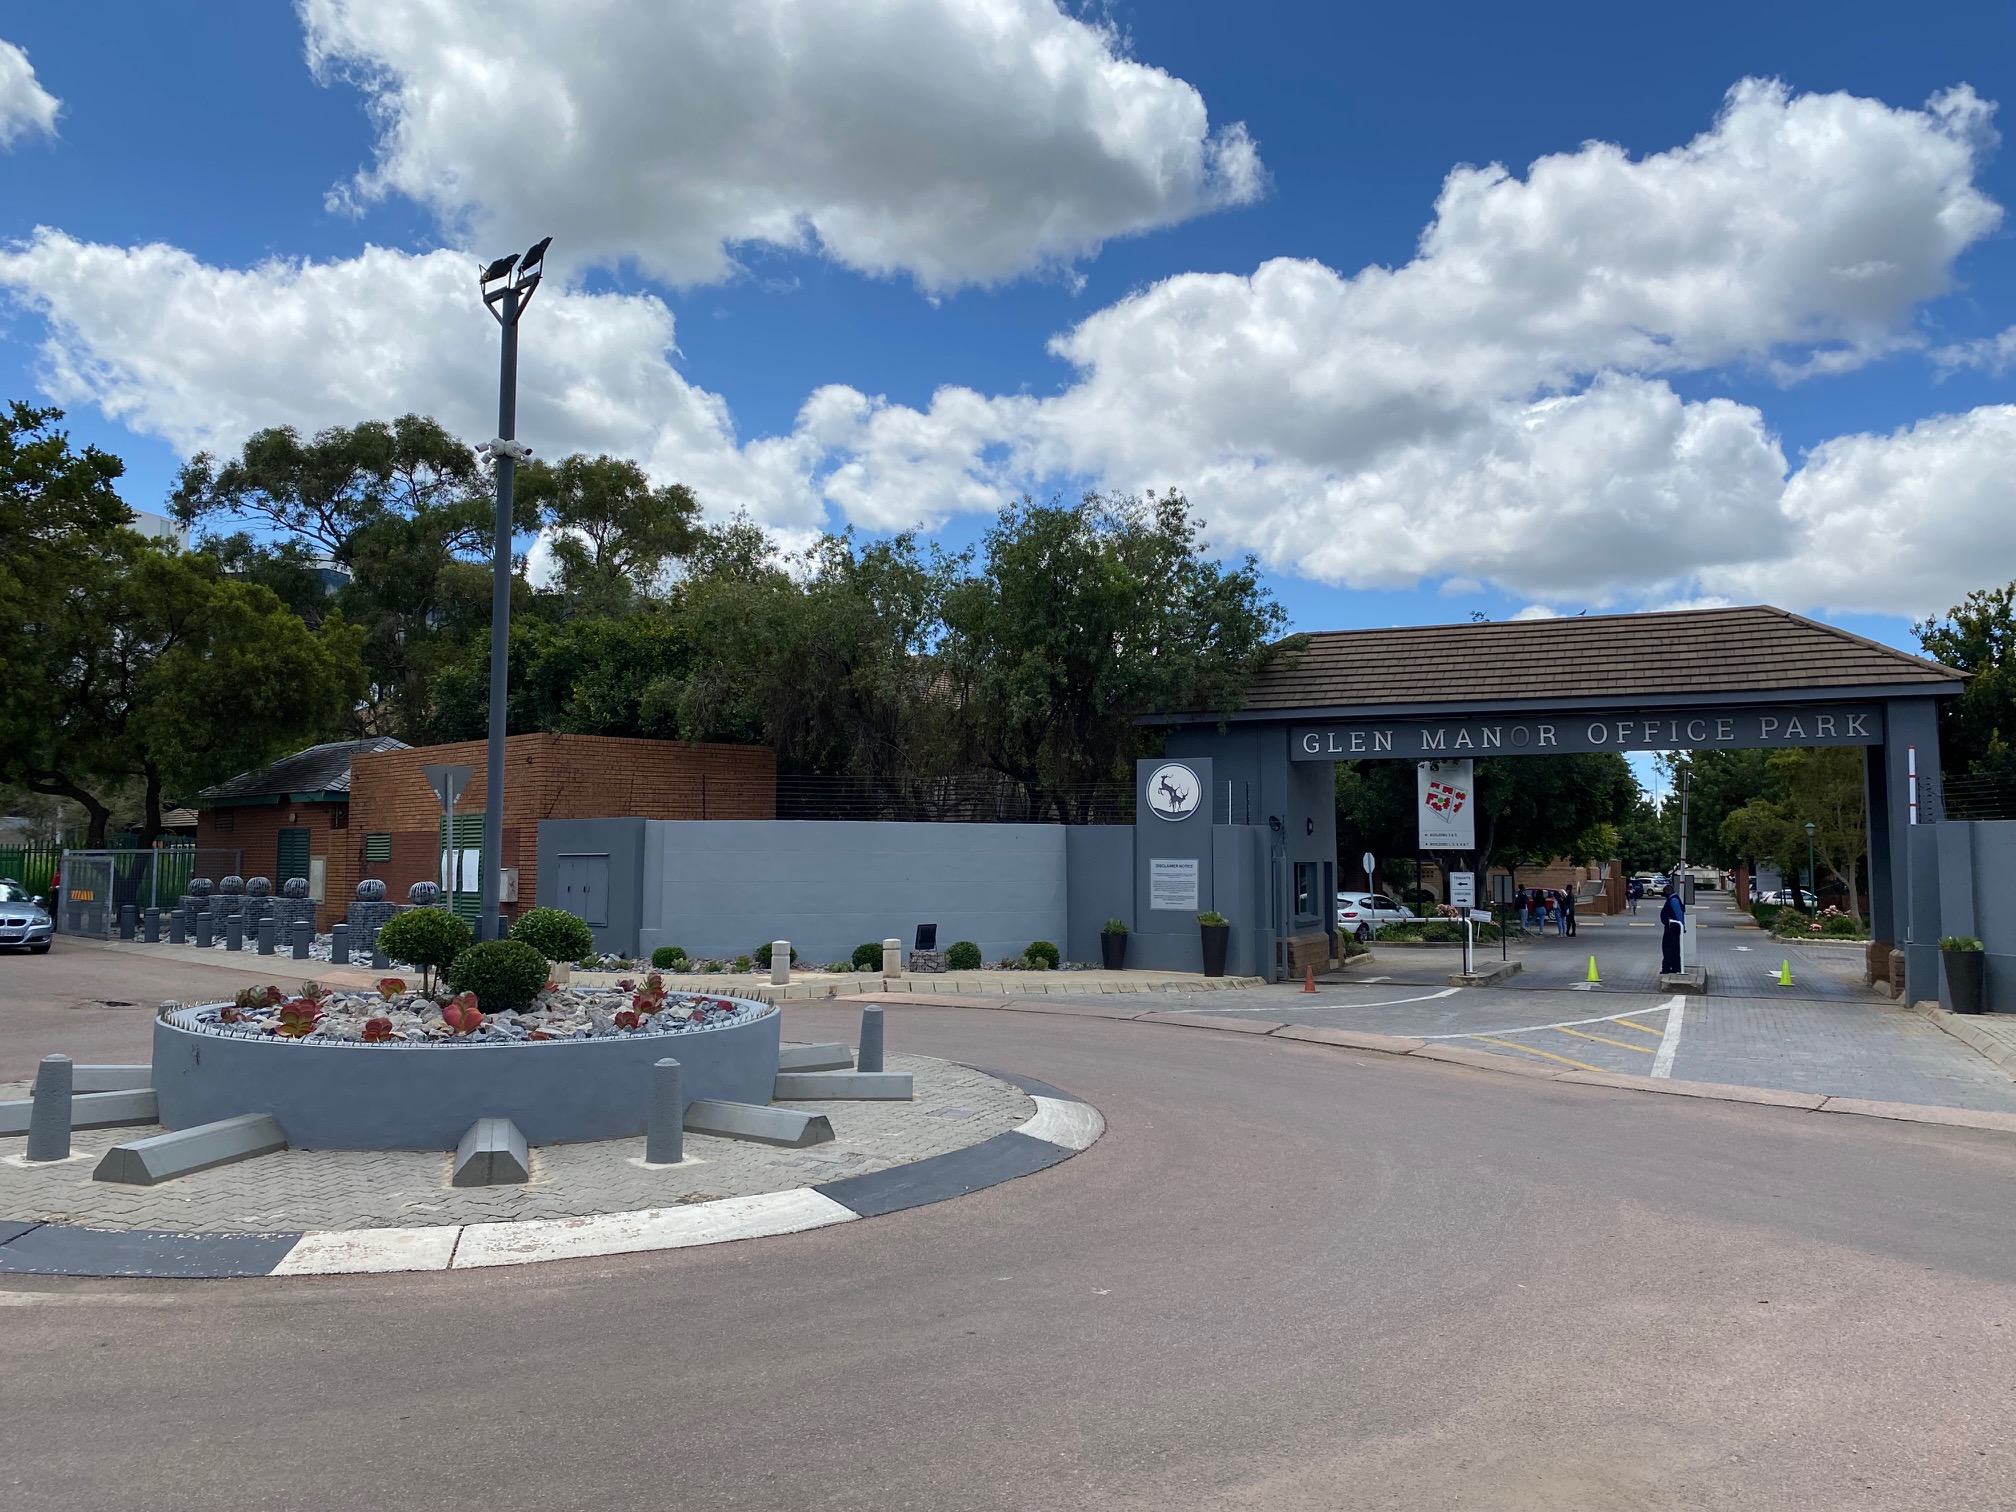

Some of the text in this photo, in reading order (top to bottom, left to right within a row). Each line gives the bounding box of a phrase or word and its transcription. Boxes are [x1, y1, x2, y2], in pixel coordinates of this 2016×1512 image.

[1302, 713, 1870, 753] GLEN MANOR OFFICE PARK
